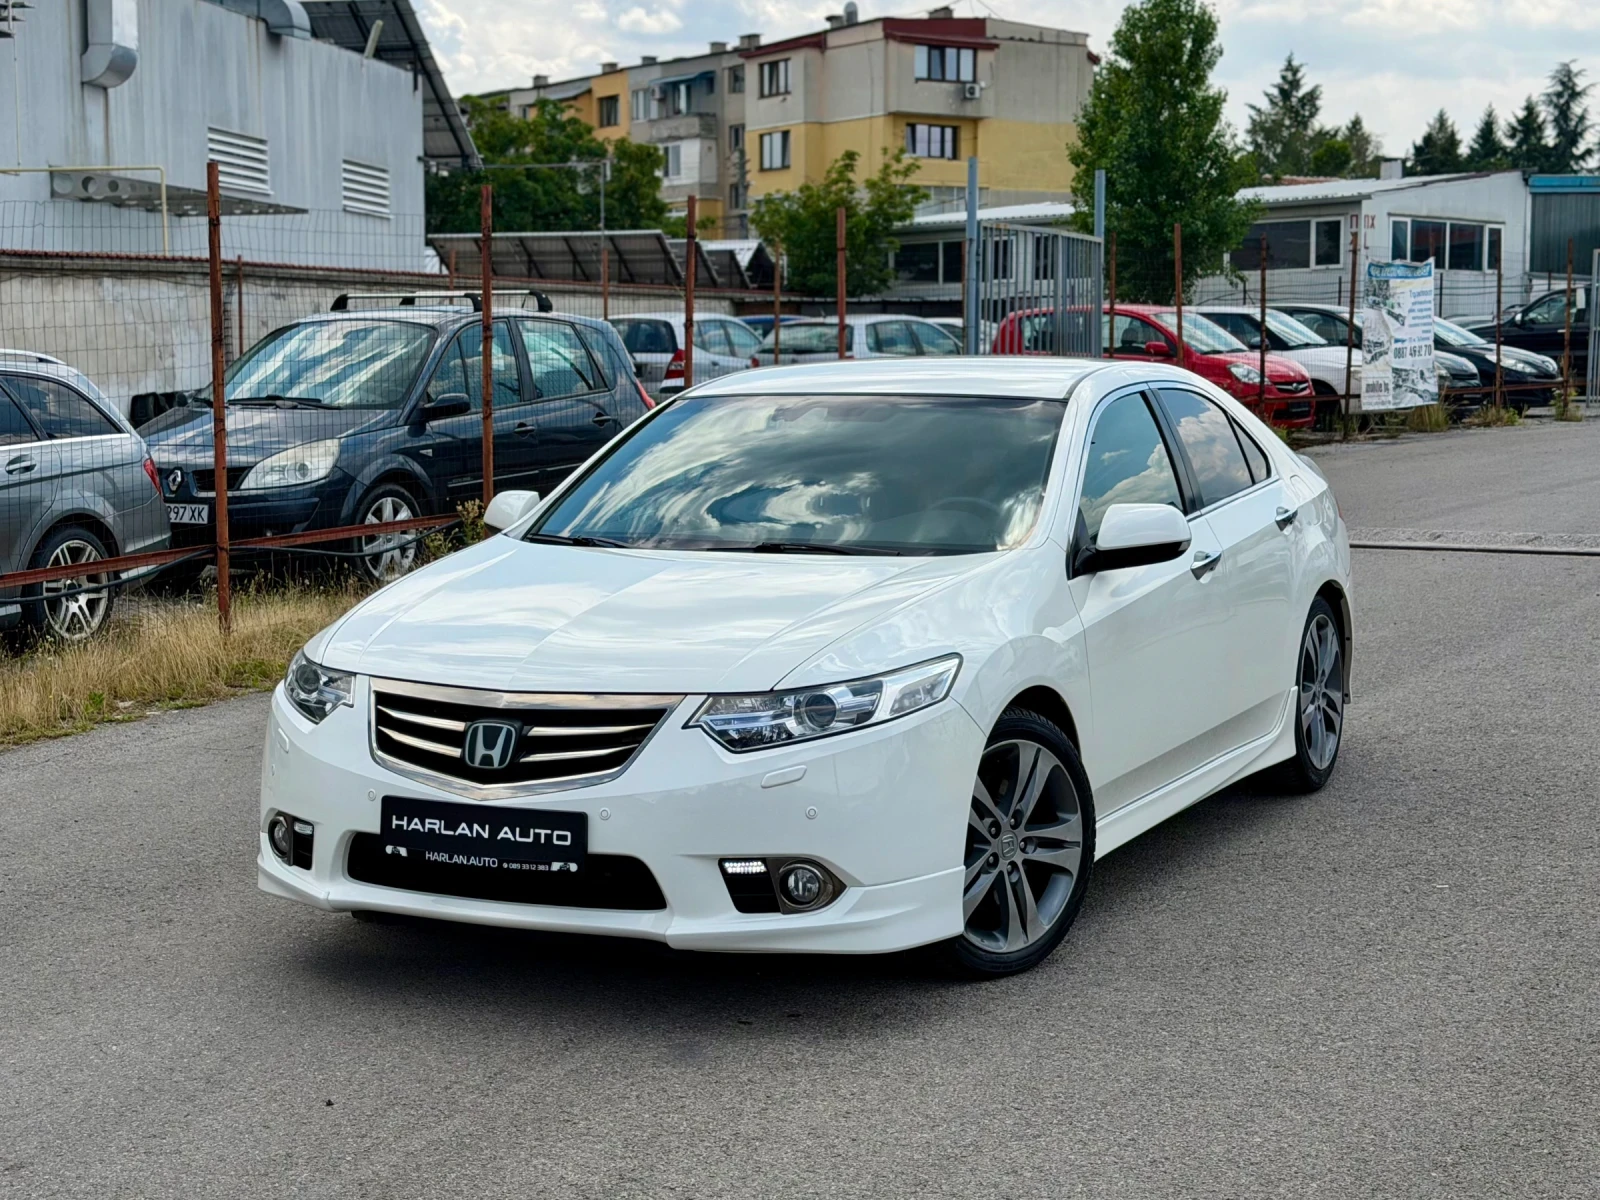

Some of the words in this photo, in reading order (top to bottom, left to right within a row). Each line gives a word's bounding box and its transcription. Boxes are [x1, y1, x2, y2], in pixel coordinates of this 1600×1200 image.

[1423, 343, 1432, 356] 70
[392, 815, 489, 839] HARLAN
[496, 826, 571, 846] AUTO
[425, 851, 498, 868] HARLAN.AUTO
